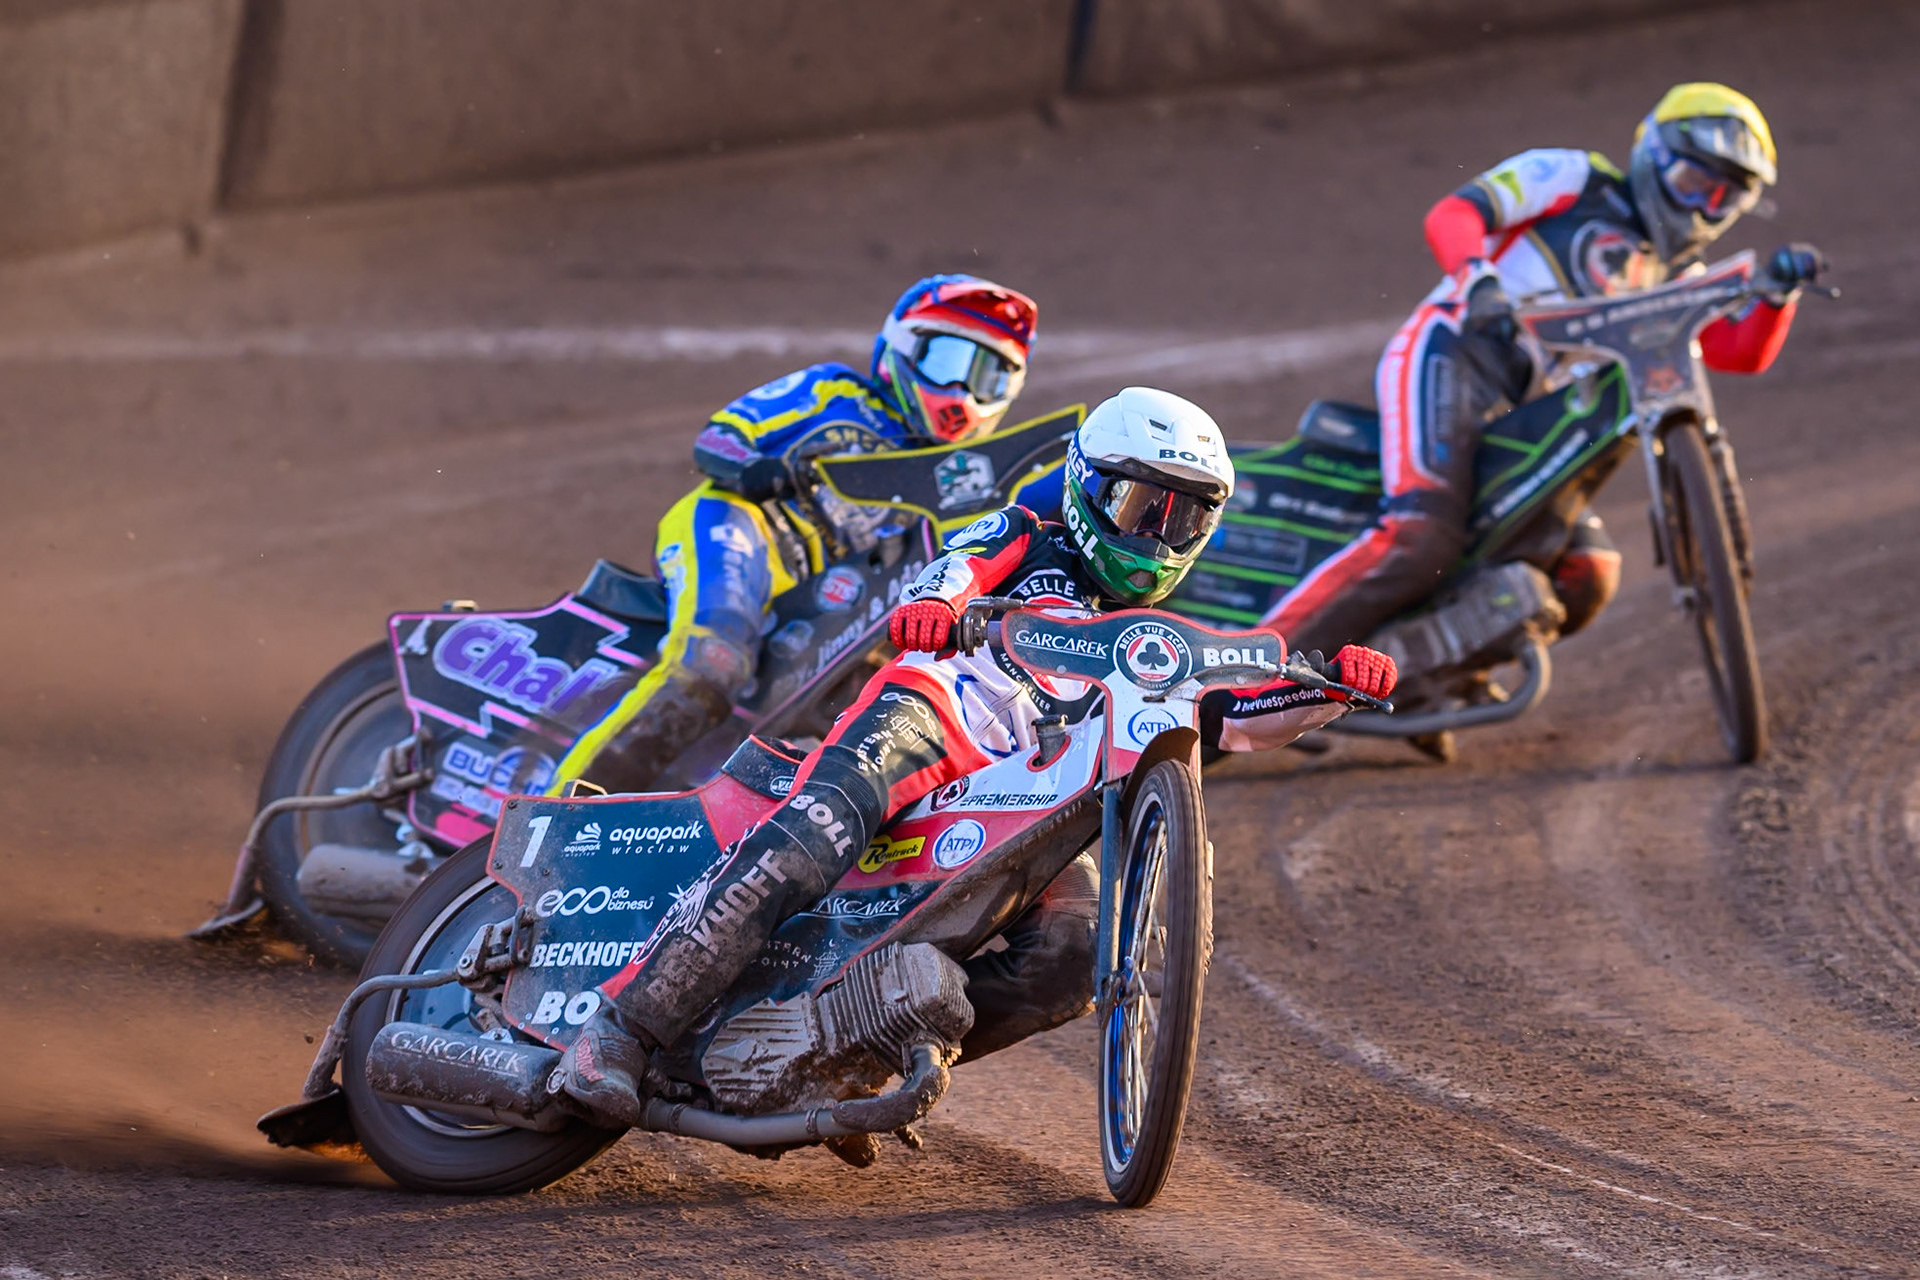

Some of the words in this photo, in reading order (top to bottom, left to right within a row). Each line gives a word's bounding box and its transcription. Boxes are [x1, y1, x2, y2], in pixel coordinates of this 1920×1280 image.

[1019, 577, 1076, 597] BELLE
[1015, 629, 1109, 658] GARCAREK
[1119, 628, 1142, 650] BELLE
[1145, 626, 1165, 636] VUE
[1167, 634, 1186, 654] ACES
[1203, 648, 1277, 670] BOLL
[1000, 652, 1051, 712] MANCHESTER
[857, 729, 894, 771] EASTERN
[609, 820, 704, 846] aquapark
[790, 794, 853, 858] BOLL
[519, 815, 553, 868] 1
[564, 842, 602, 854] aquapark
[942, 838, 976, 852] ATPI
[607, 899, 653, 911] biznesu
[611, 886, 630, 898] dla
[812, 898, 907, 916] ARCAREK
[531, 990, 601, 1026] BO
